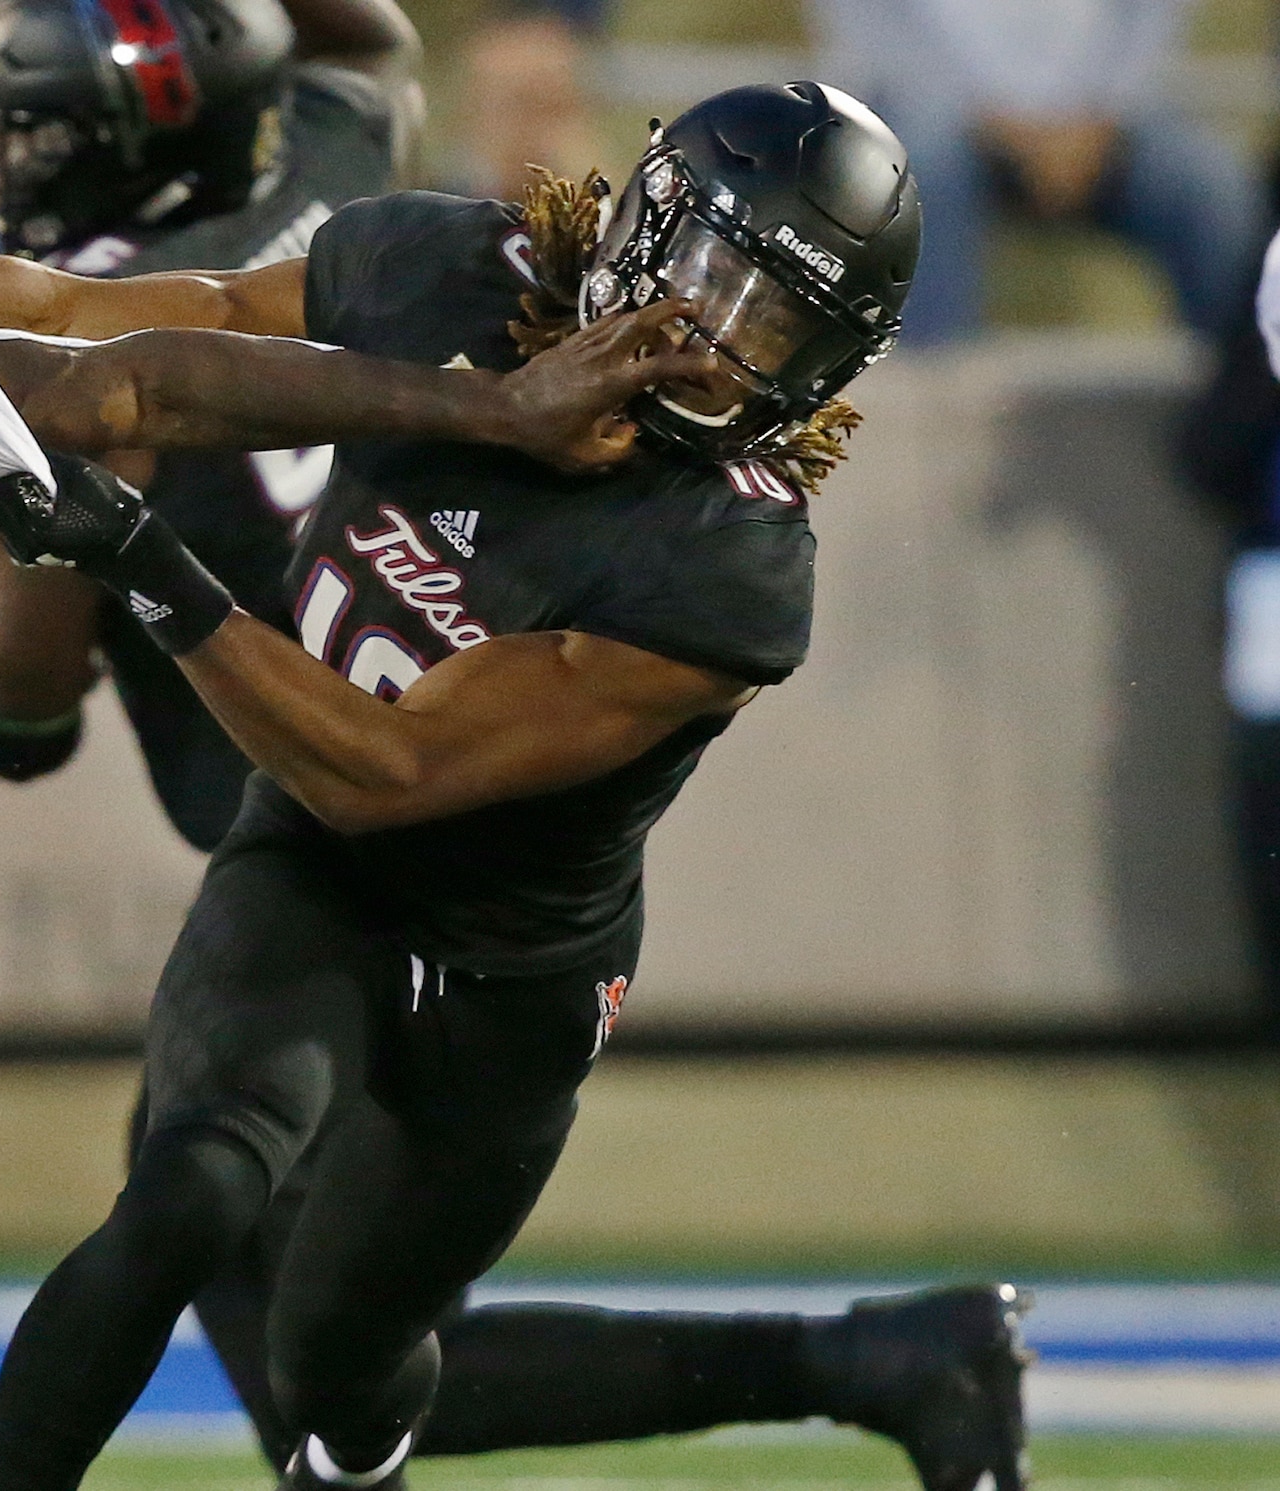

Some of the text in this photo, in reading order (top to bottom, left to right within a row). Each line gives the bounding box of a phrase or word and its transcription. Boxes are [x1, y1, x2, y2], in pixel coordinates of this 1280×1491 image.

[774, 224, 845, 283] Riddell
[430, 511, 476, 559] adidas
[345, 504, 491, 651] Tulsa
